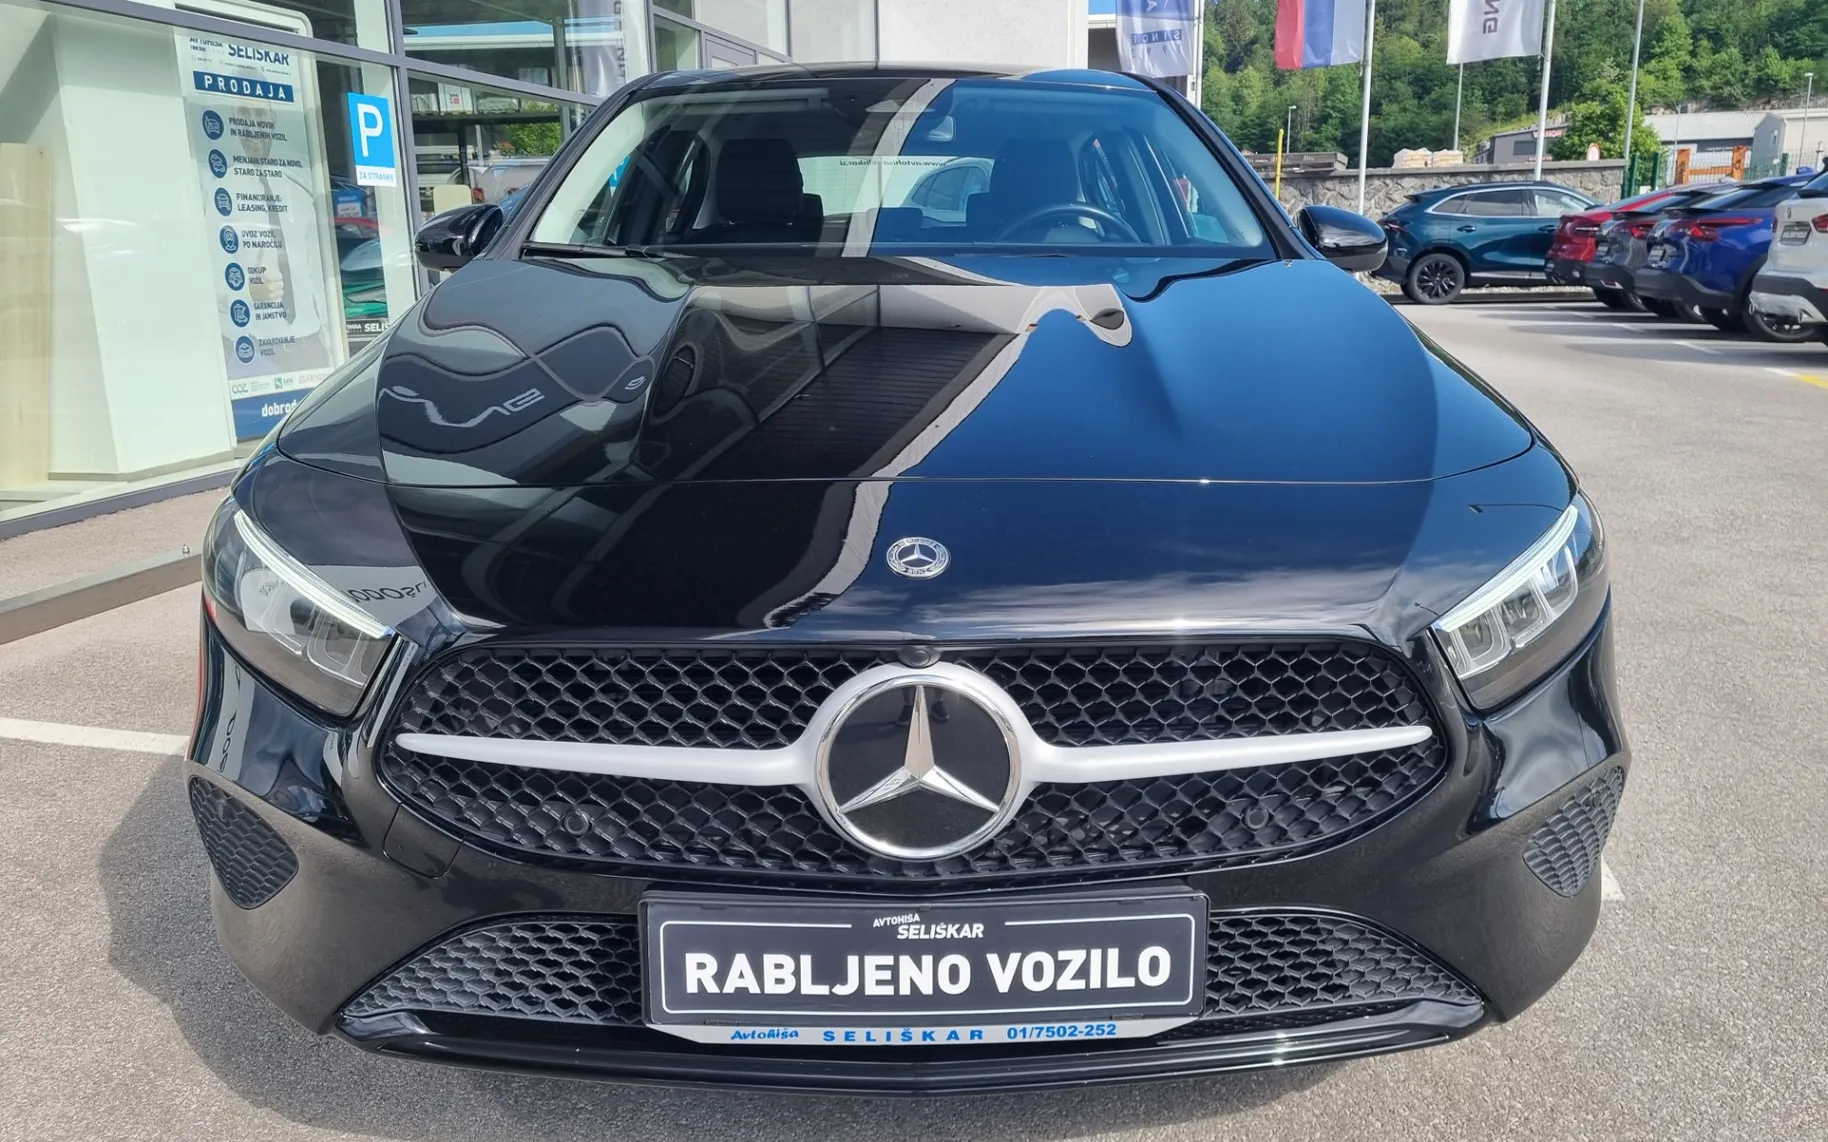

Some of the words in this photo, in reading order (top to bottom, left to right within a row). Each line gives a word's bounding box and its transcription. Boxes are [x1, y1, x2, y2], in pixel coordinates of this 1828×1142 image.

[204, 75, 286, 100] PRODAJA
[228, 117, 256, 128] PRODAJA
[257, 120, 275, 129] NOVIH
[230, 128, 237, 136] IN
[238, 129, 270, 140] RABLJENIH
[357, 103, 383, 157] P
[259, 157, 279, 166] STARO
[279, 158, 286, 167] ZA
[234, 167, 255, 176] STARO
[256, 169, 263, 177] ZA
[263, 169, 282, 178] STARO
[359, 172, 367, 180] ZA
[237, 204, 267, 213] LEASING,
[268, 204, 288, 212] KREDIT
[241, 230, 258, 238] UVOZ
[259, 230, 276, 238] VOZIL
[247, 266, 267, 275] ODKUP
[249, 276, 264, 284] VOZIL
[254, 301, 284, 310] GARANCIJA
[255, 313, 261, 321] IN
[262, 311, 287, 320] JAMSTVO
[259, 336, 296, 346] ZAVAROVANJE
[260, 348, 275, 356] VOZIL
[873, 913, 920, 928] AVTOHIŠA
[897, 922, 984, 939] SELIŠKAR
[684, 952, 971, 997] RABLJENO
[986, 945, 1171, 993] VOZILO
[731, 1027, 799, 1040] Avtohiša
[823, 1027, 984, 1043] SELIŠKAR
[1007, 1023, 1117, 1040] 01/7502-252
